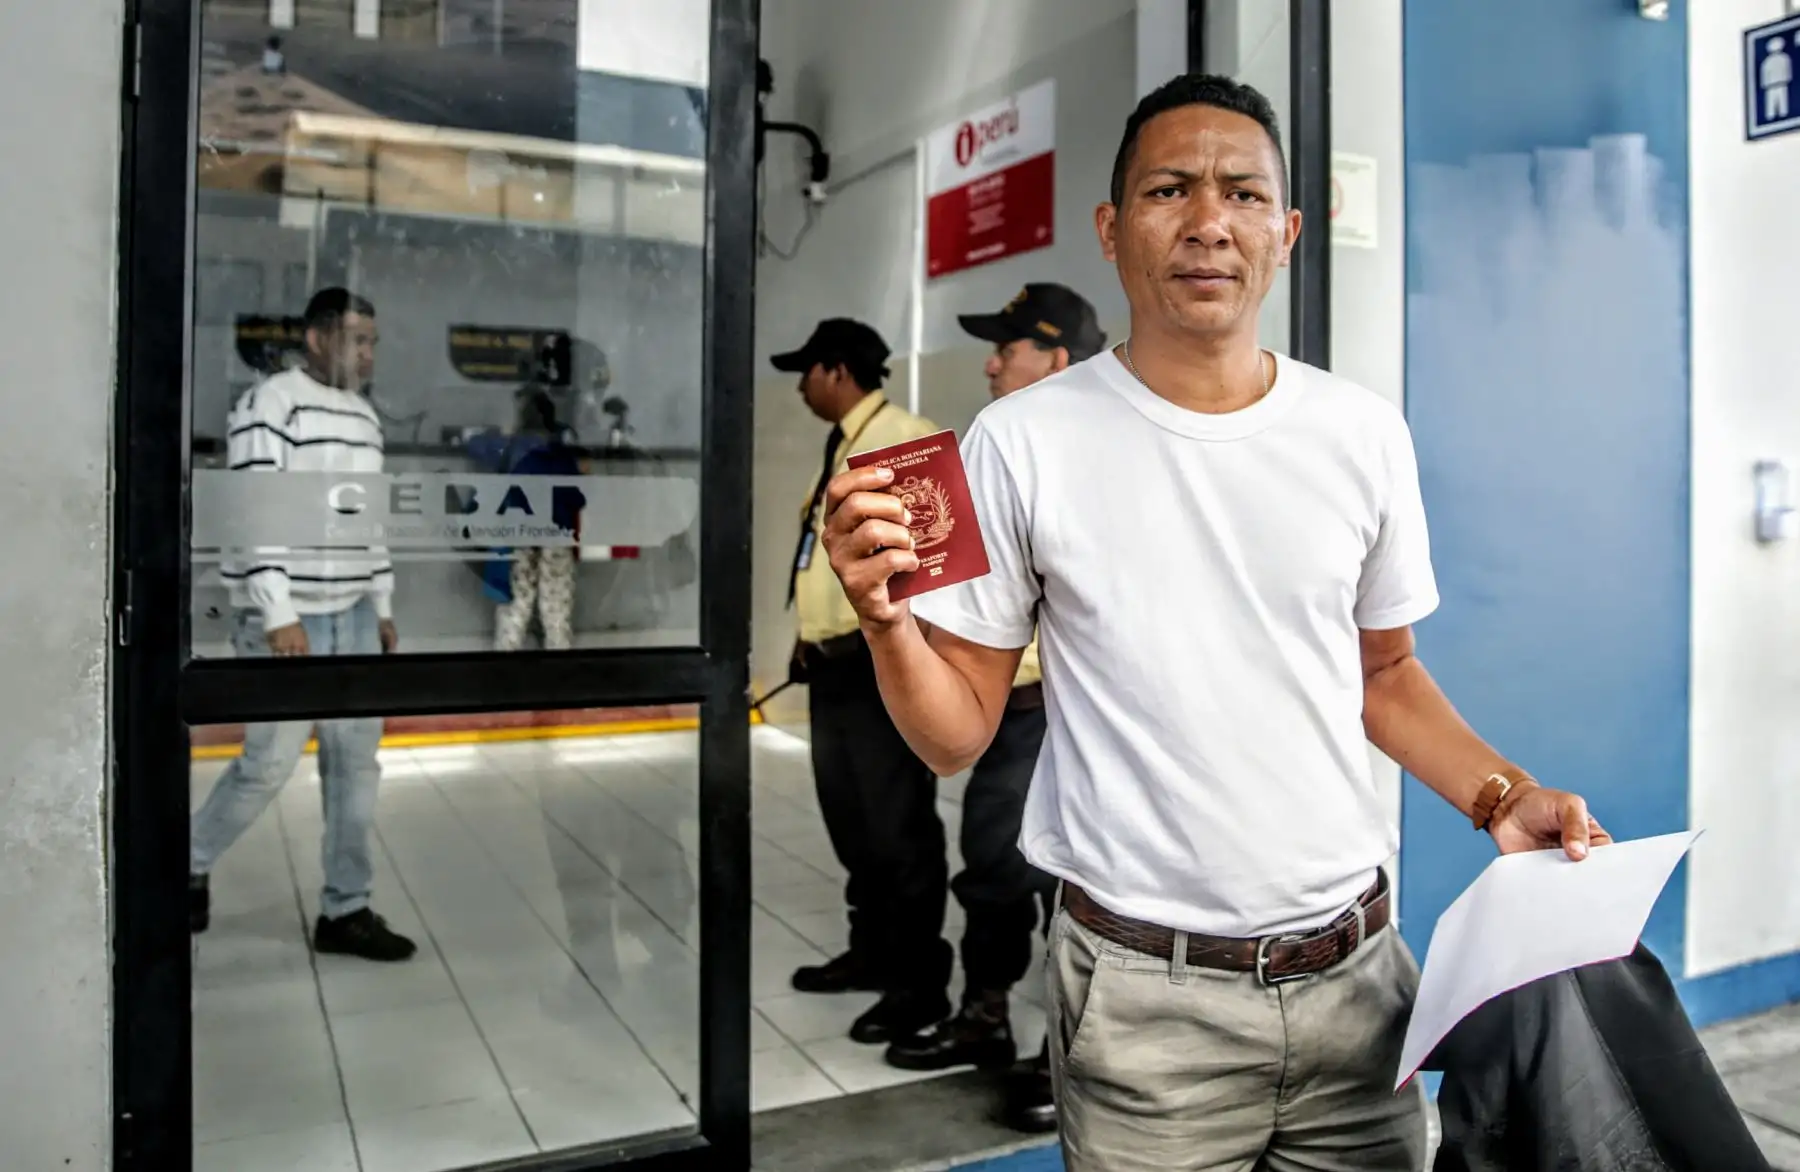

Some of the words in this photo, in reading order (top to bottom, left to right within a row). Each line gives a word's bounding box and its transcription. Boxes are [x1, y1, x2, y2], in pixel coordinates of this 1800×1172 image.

[901, 445, 942, 460] BOLIVARIANA
[893, 456, 929, 470] VENEZUELA
[920, 551, 948, 563] ASAPORTE
